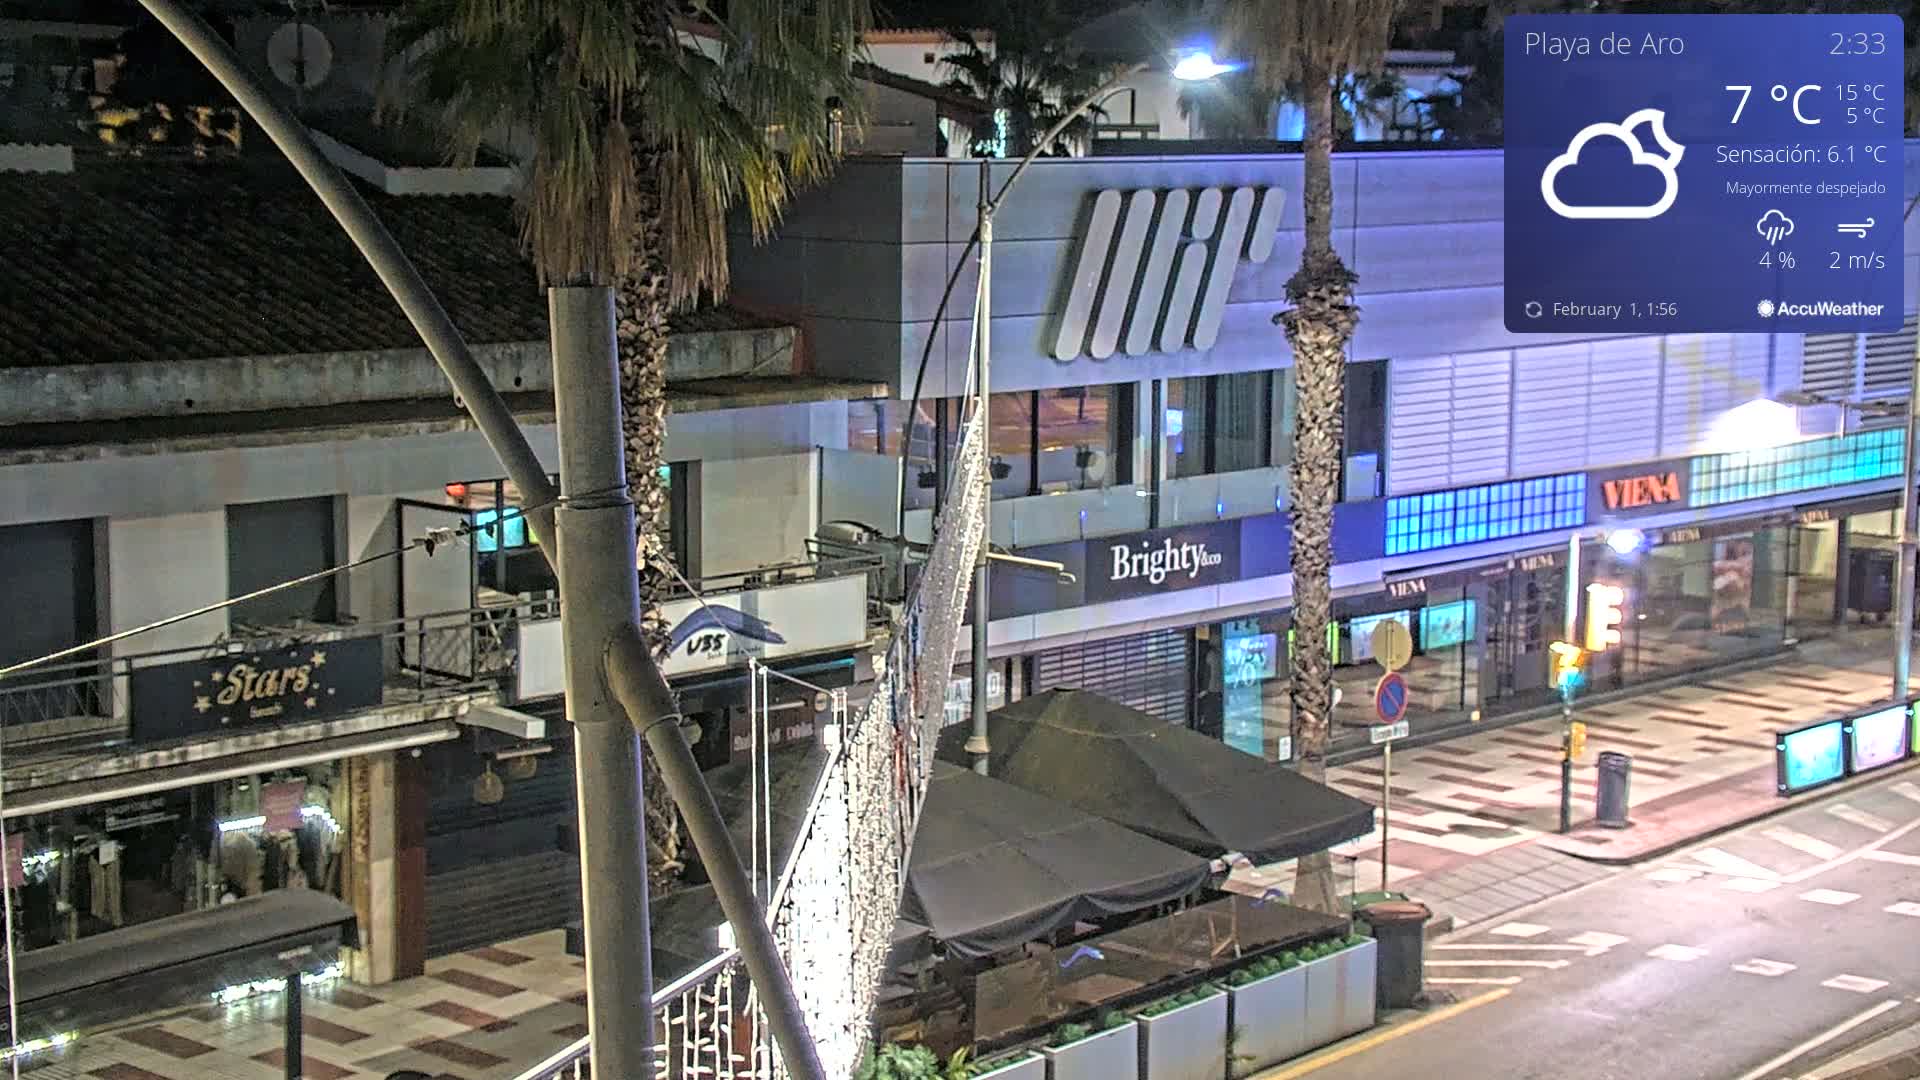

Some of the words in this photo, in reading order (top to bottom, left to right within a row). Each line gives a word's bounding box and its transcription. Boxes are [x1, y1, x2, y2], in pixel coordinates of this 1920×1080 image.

[1602, 470, 1681, 509] VIENA
[1389, 577, 1427, 598] VIENA
[217, 663, 312, 706] Stars
